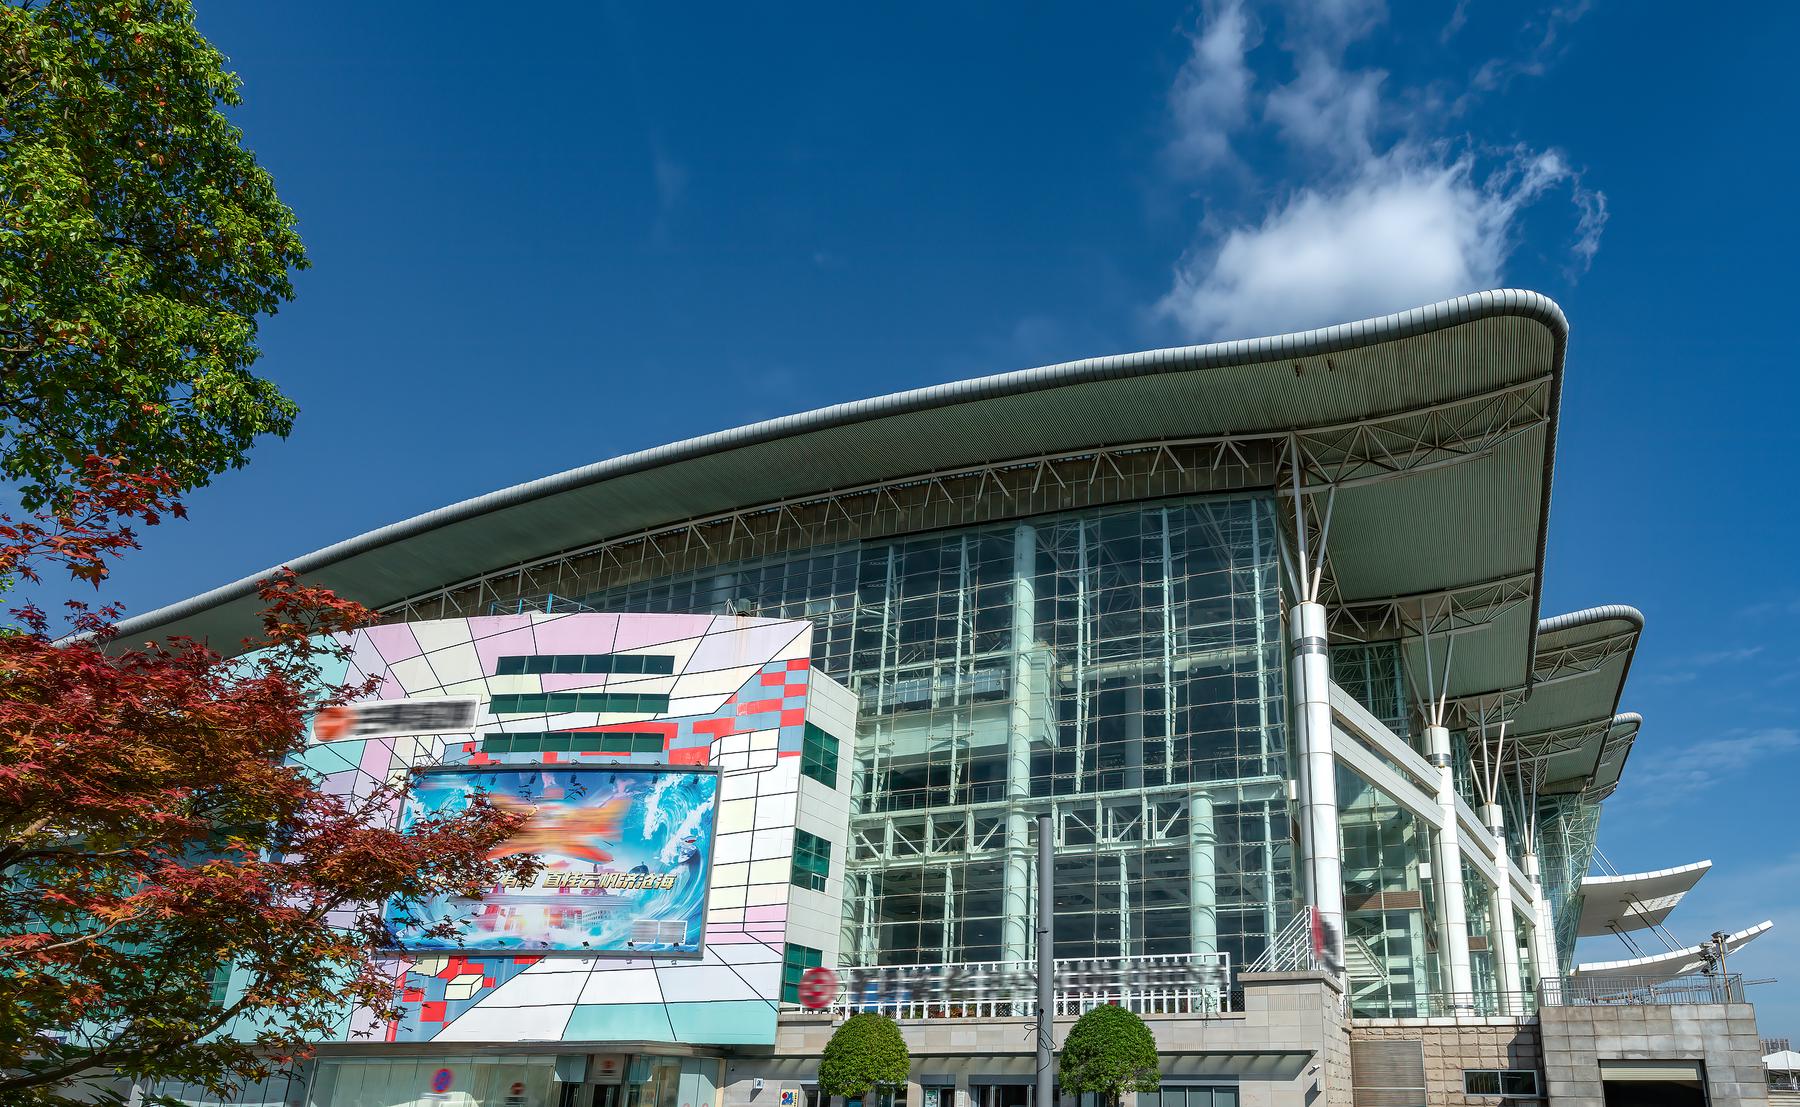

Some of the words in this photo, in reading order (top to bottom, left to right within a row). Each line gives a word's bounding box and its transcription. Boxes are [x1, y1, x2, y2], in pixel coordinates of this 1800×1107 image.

[542, 872, 677, 890] 直挂云帆济沧海
